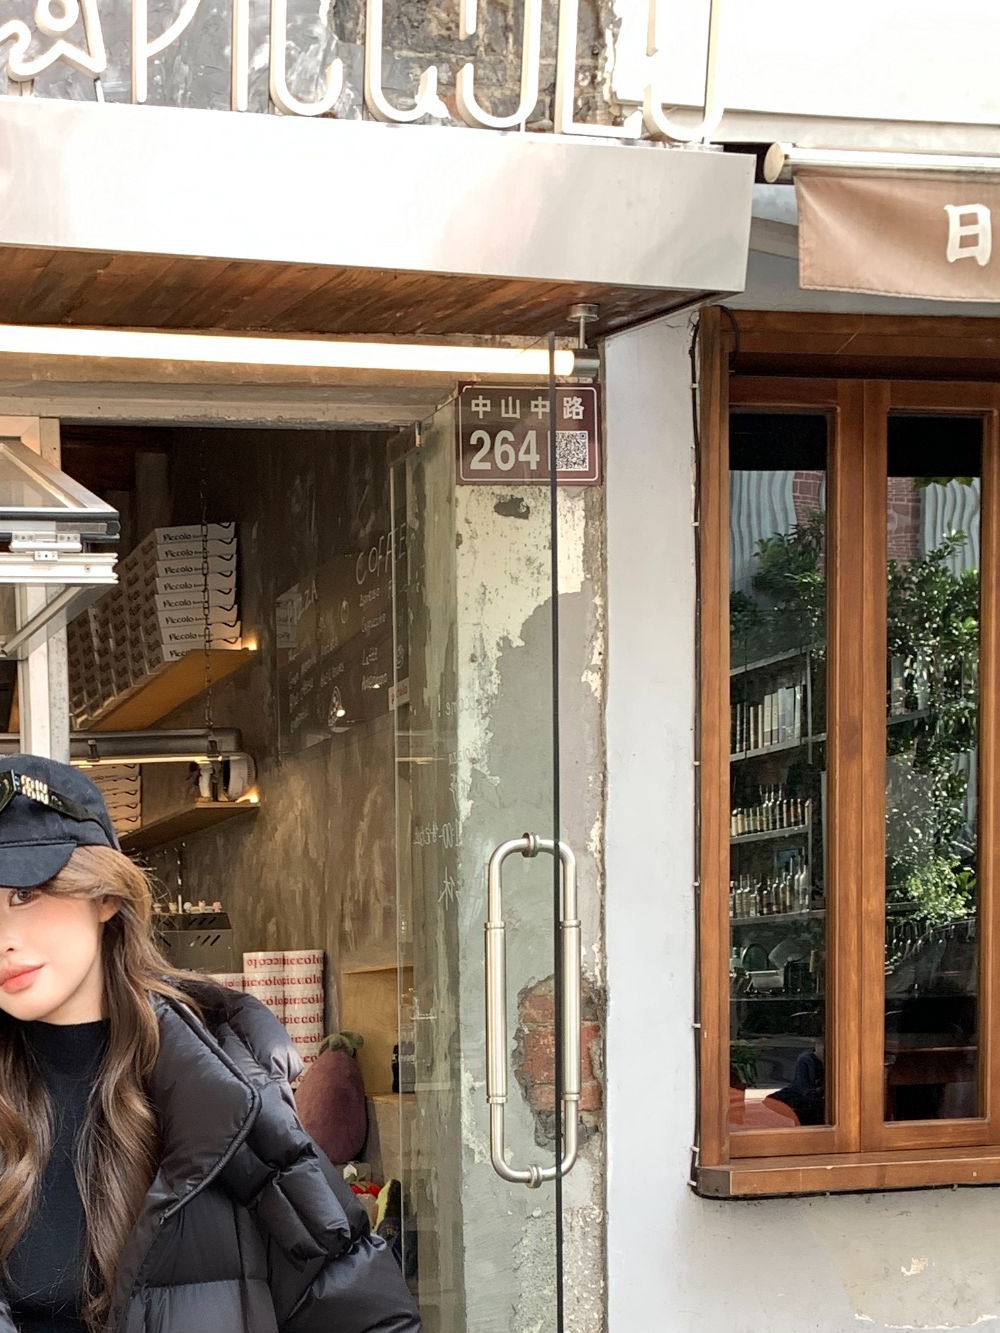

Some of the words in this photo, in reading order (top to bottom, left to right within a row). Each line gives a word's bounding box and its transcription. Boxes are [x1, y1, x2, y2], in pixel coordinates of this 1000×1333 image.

[943, 203, 992, 266] 日
[471, 395, 585, 420] 中山中路
[469, 430, 541, 471] 264
[356, 522, 406, 585] COFFE
